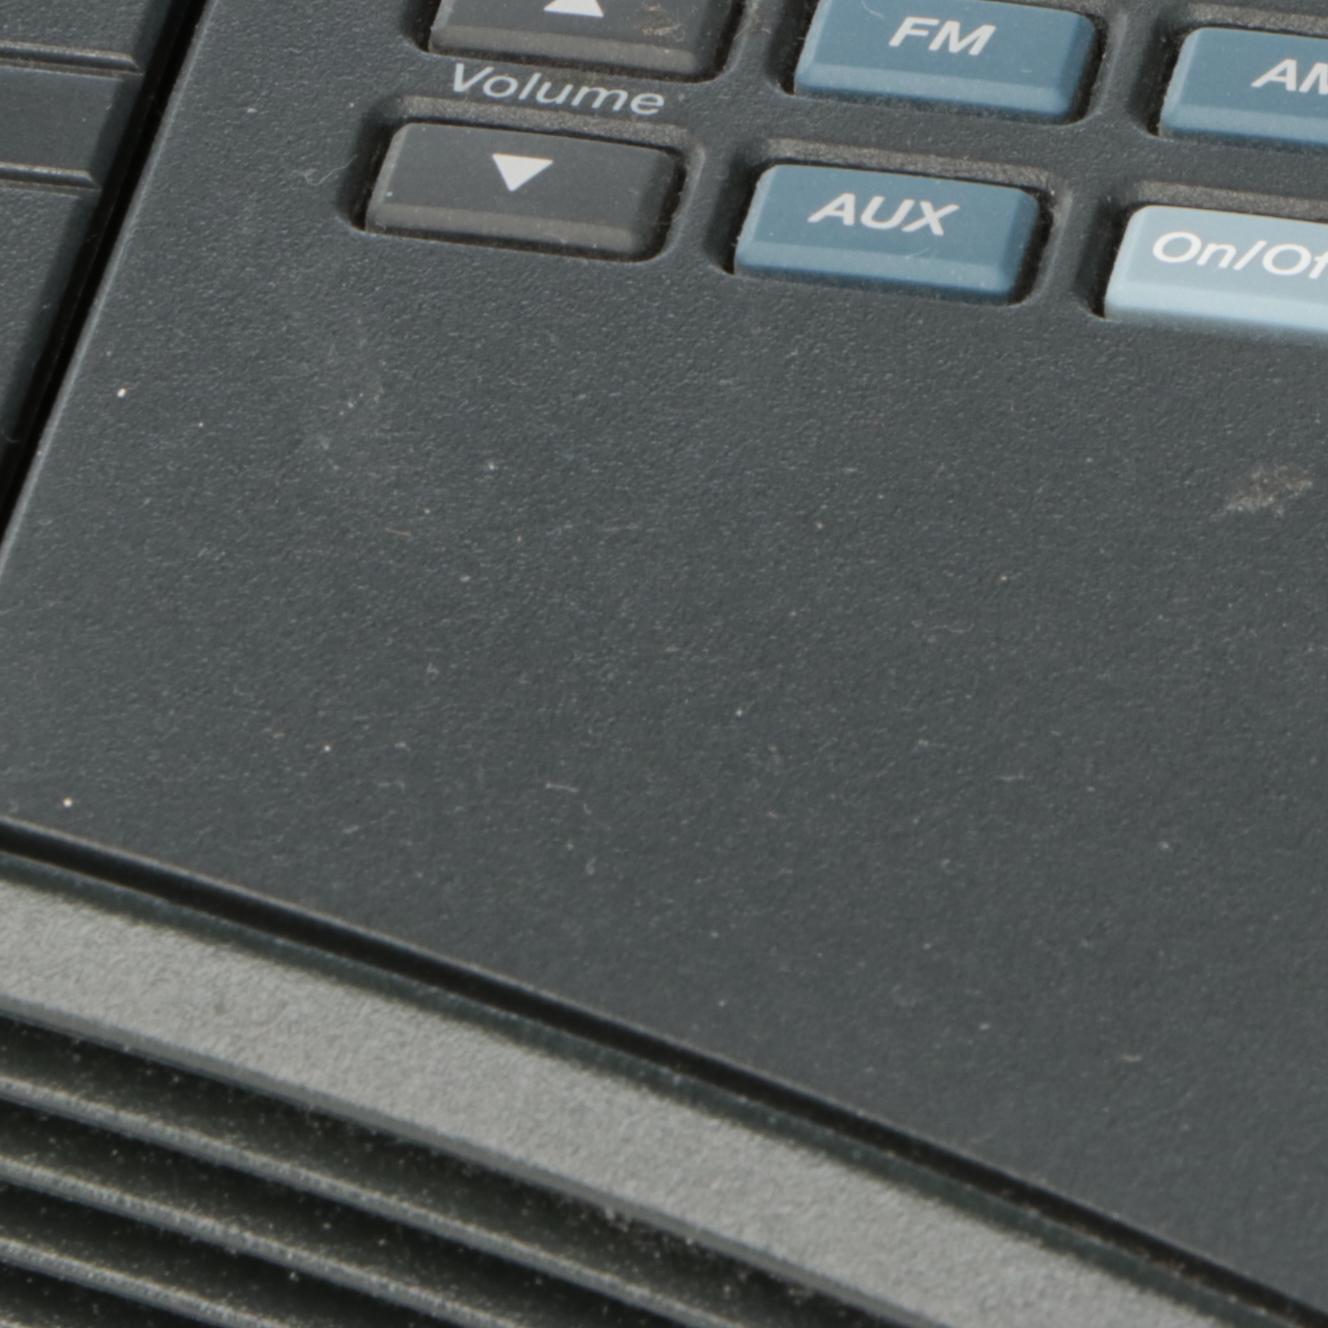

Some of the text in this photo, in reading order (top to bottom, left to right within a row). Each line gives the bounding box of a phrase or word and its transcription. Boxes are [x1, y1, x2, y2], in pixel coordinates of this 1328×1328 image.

[887, 15, 997, 58] FM
[451, 60, 666, 117] Volume
[806, 191, 961, 238] AUX
